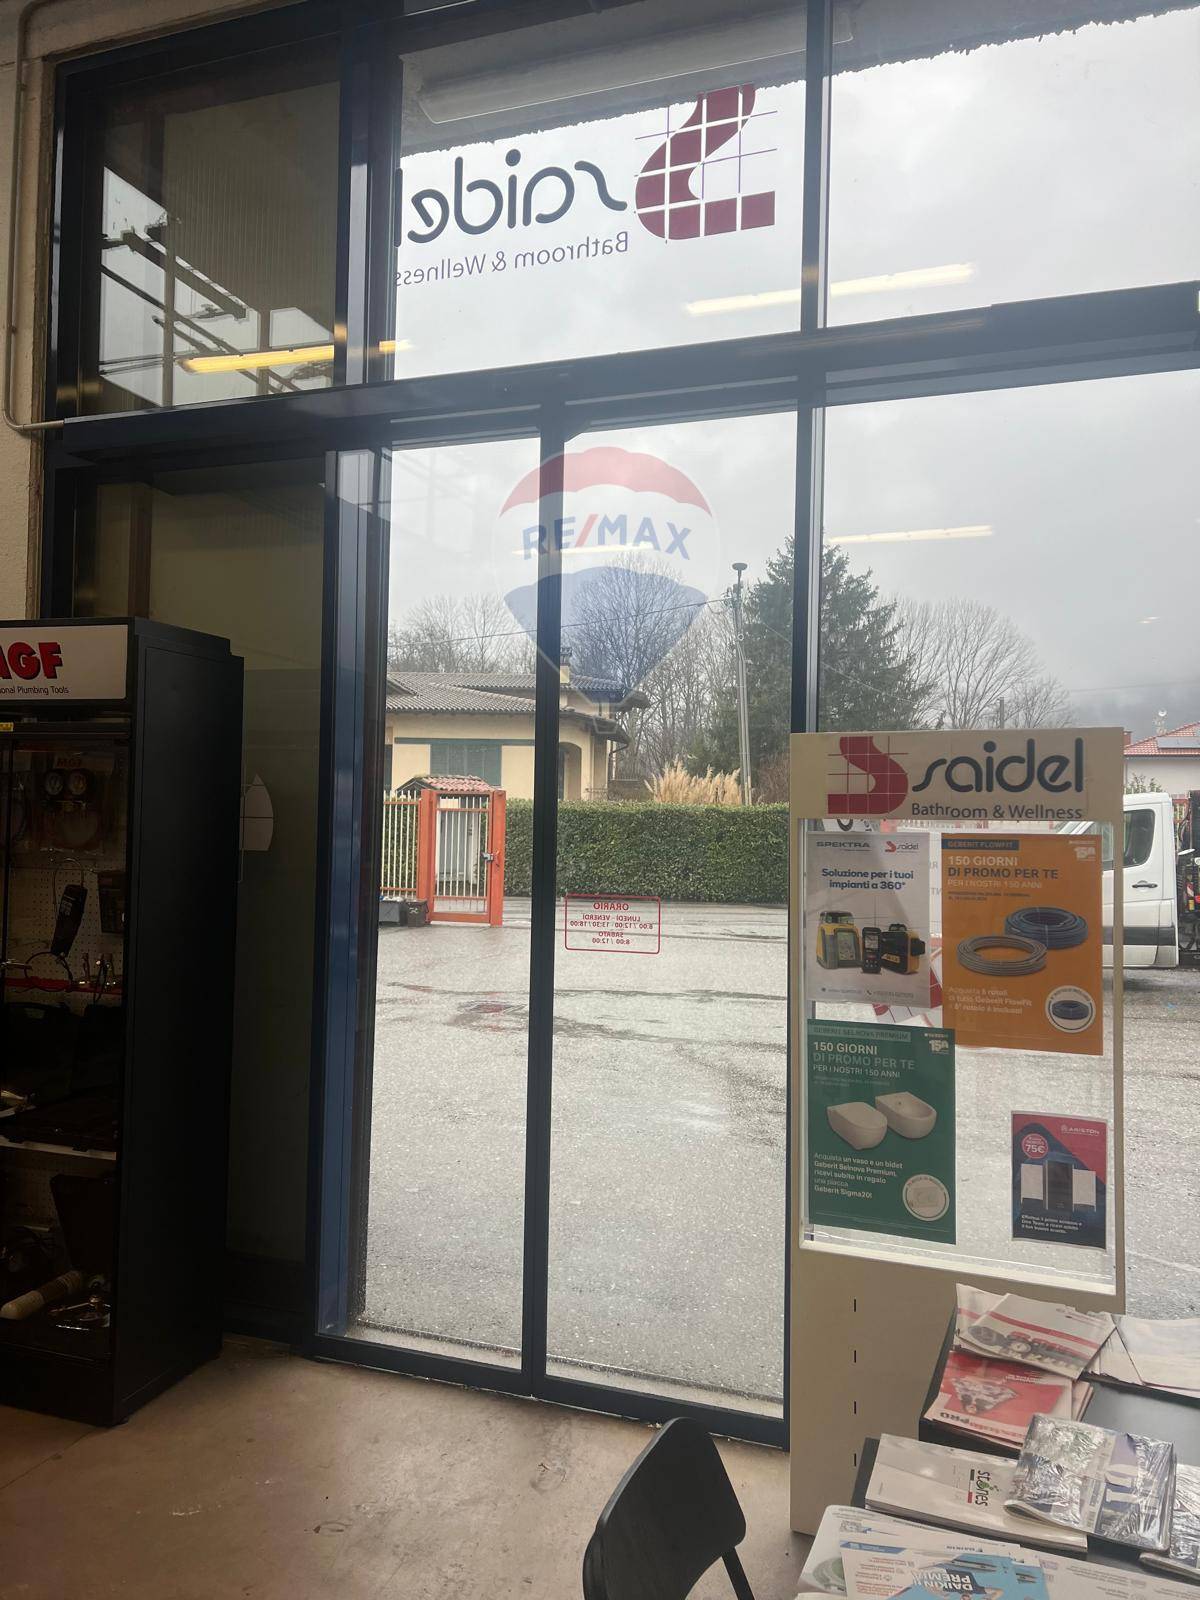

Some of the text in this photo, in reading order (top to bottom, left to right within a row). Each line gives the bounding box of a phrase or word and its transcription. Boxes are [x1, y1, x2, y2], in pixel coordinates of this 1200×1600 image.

[17, 685, 49, 696] Plumbing
[50, 685, 70, 694] Tools
[911, 737, 1084, 793] saidel
[911, 803, 1083, 820] Bathroom & Wellness
[948, 856, 1018, 866] 150 GIORNI
[821, 868, 868, 877] Soluzione
[871, 871, 887, 880] per
[894, 870, 914, 879] tuoi
[948, 868, 1058, 879] DI PROMO PER TE
[829, 880, 870, 890] impianti
[880, 881, 906, 890] 360°
[947, 879, 964, 887] PER
[813, 1042, 878, 1055] 150 GIORNI
[813, 1052, 916, 1070] DI PROMO PER TE
[813, 1064, 828, 1072] PER
[834, 1066, 862, 1075] NOSTRI
[865, 1068, 880, 1077] 150
[880, 1070, 900, 1078] ANNI
[1025, 1144, 1046, 1154] 75€
[814, 1152, 842, 1162] Acquista
[885, 1161, 903, 1169] bidet
[814, 1161, 838, 1169] Geberit
[814, 1169, 833, 1177] ricevi
[834, 1171, 855, 1181] subito
[864, 1175, 887, 1184] regalo
[814, 1185, 840, 1194] Geberit
[975, 1470, 991, 1507] stones
[924, 1579, 974, 1591] DAIKIN
